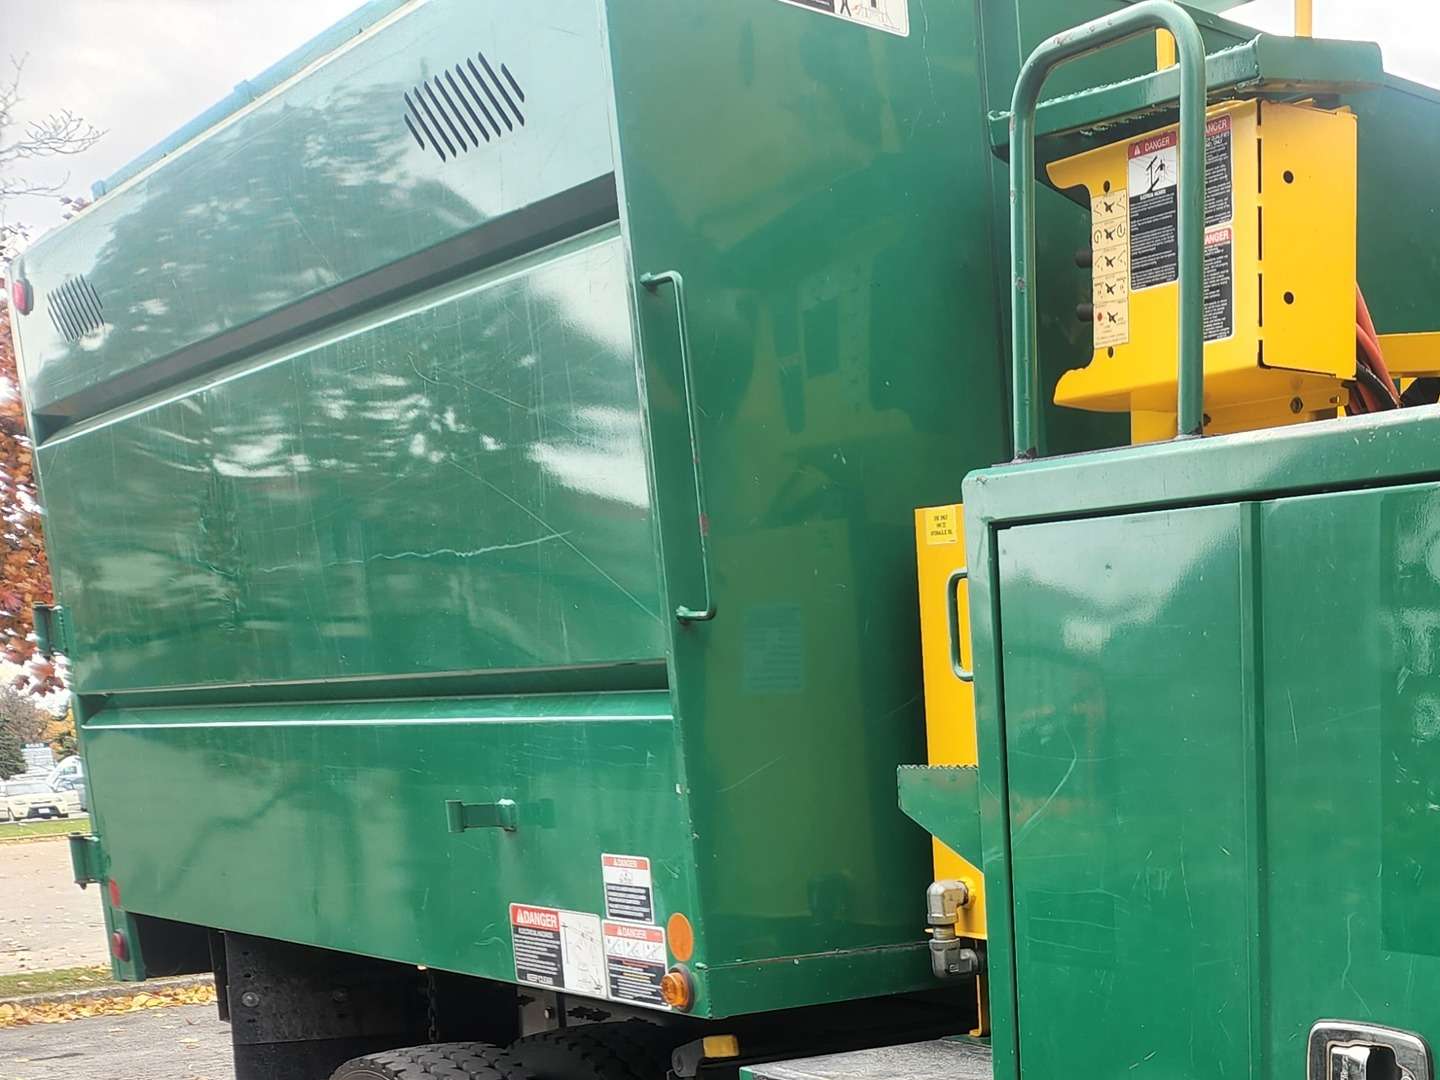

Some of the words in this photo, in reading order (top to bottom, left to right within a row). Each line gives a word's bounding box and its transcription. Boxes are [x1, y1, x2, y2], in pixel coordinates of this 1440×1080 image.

[1144, 138, 1170, 152] DANGER
[1205, 230, 1229, 244] ANGER
[523, 910, 557, 928] DANGER
